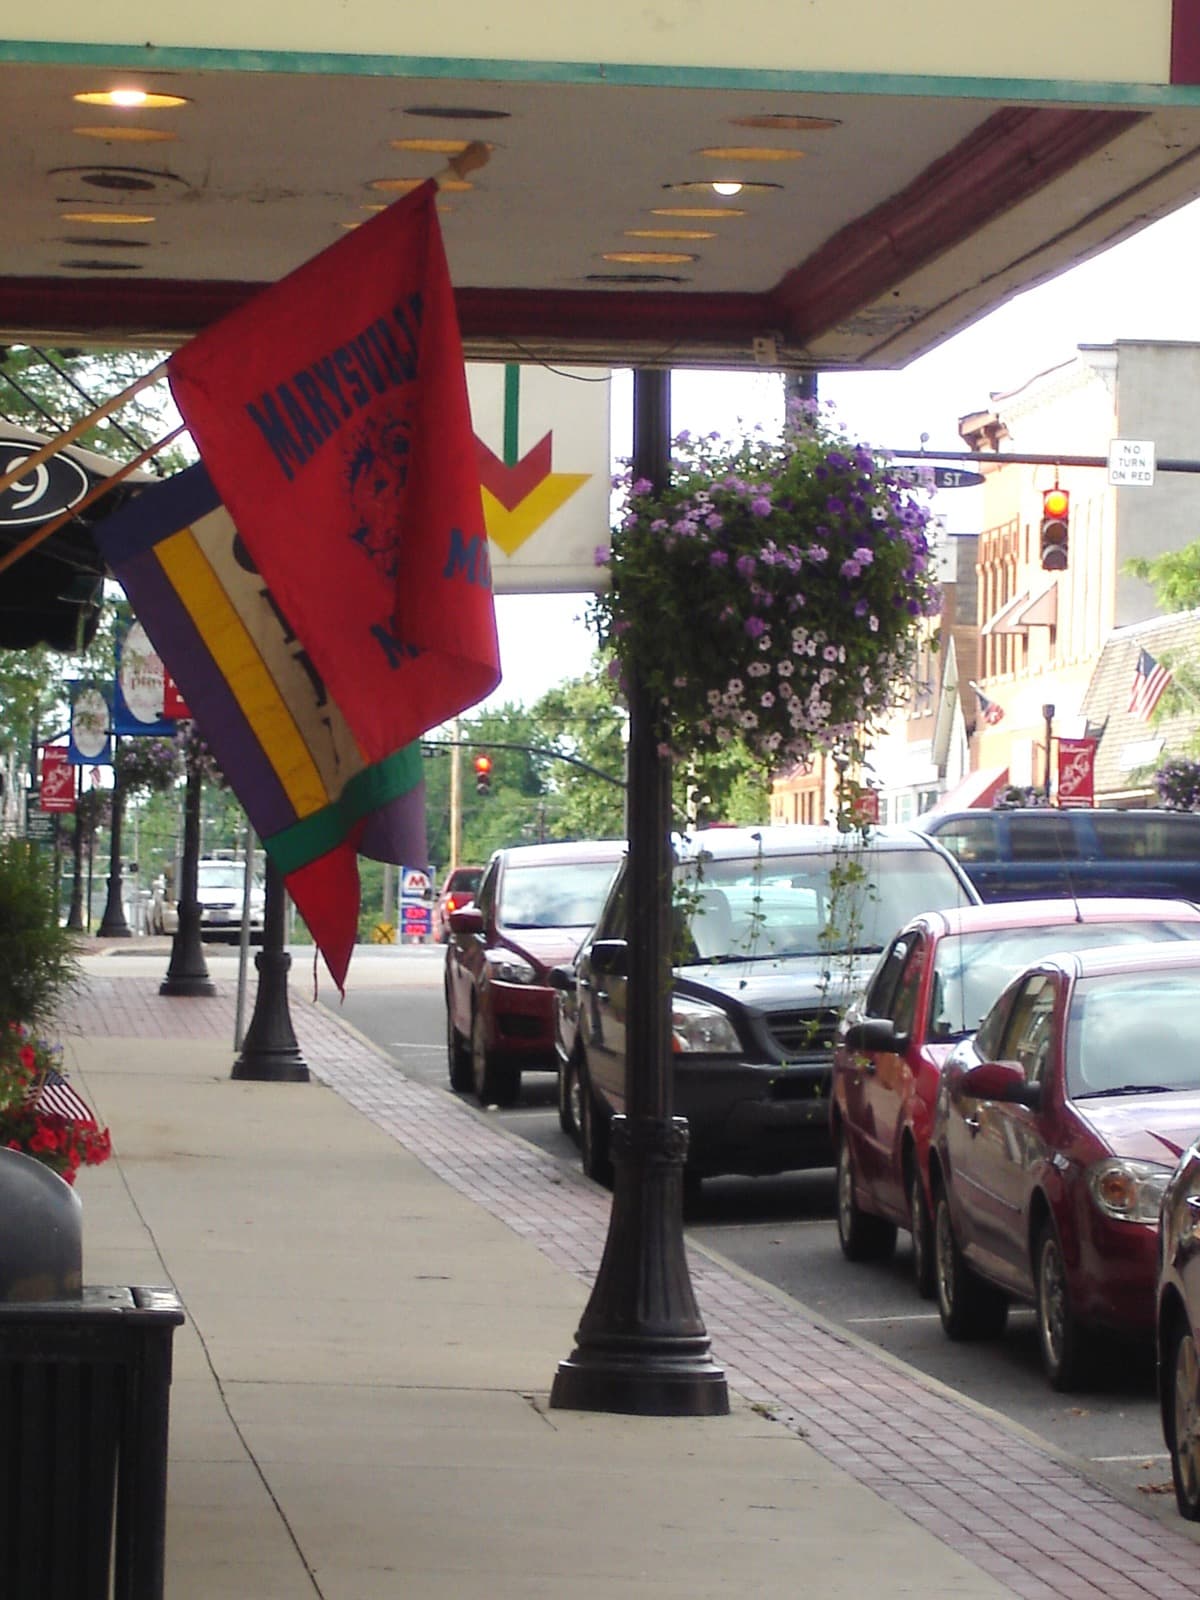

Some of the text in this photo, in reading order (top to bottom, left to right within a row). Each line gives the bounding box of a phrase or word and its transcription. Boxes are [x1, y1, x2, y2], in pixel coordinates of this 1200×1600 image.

[1123, 445, 1141, 454] NO
[1119, 458, 1146, 467] TURN
[943, 472, 962, 486] ST
[1111, 470, 1151, 481] ON RED
